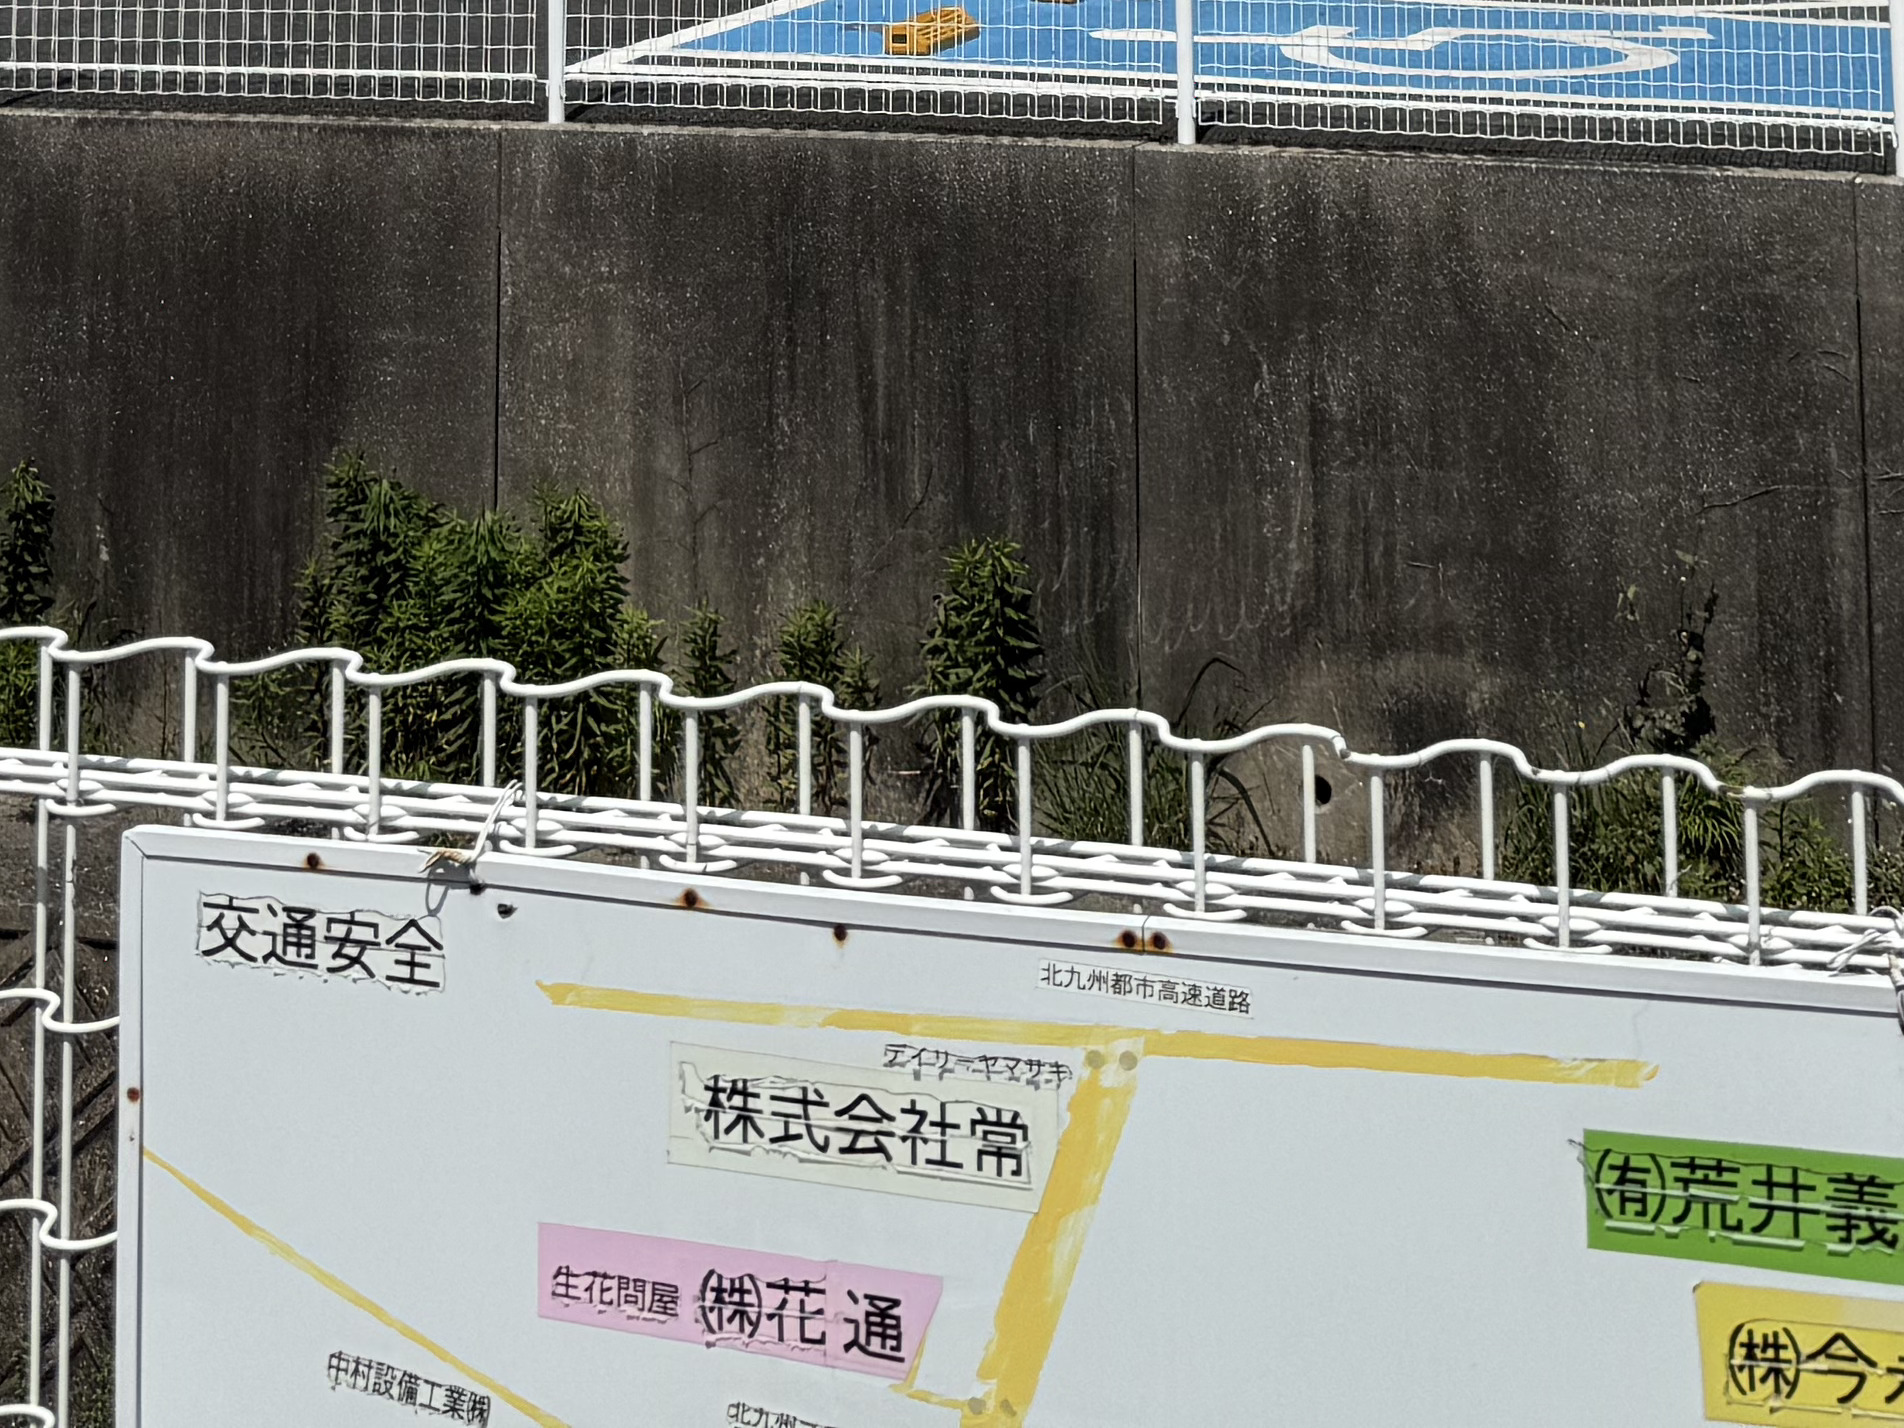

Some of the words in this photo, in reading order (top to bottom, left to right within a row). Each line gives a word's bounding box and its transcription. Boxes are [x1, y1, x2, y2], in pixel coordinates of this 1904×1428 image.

[202, 896, 444, 988] 交通安全
[1040, 963, 1252, 1015] 北九州都市高速道路
[704, 1074, 1029, 1177] 株式会社常
[552, 1265, 680, 1318] 生花問屋
